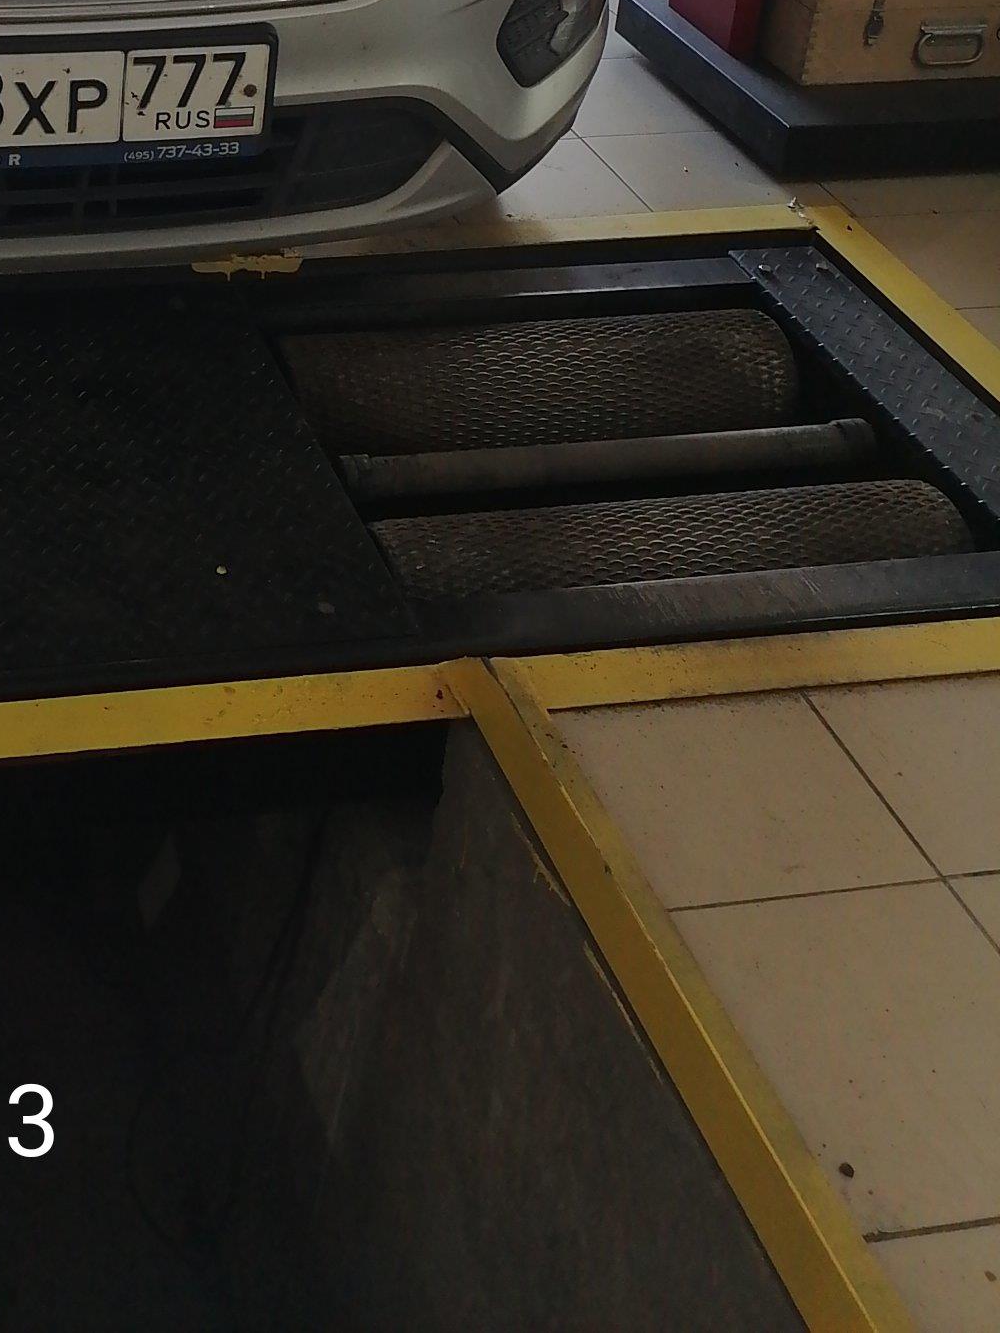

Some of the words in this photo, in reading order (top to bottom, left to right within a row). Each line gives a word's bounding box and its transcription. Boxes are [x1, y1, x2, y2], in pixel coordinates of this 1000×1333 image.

[132, 52, 247, 110] 777
[155, 110, 210, 130] RUS
[123, 150, 155, 163] (495)
[156, 141, 240, 160] 737-43-33
